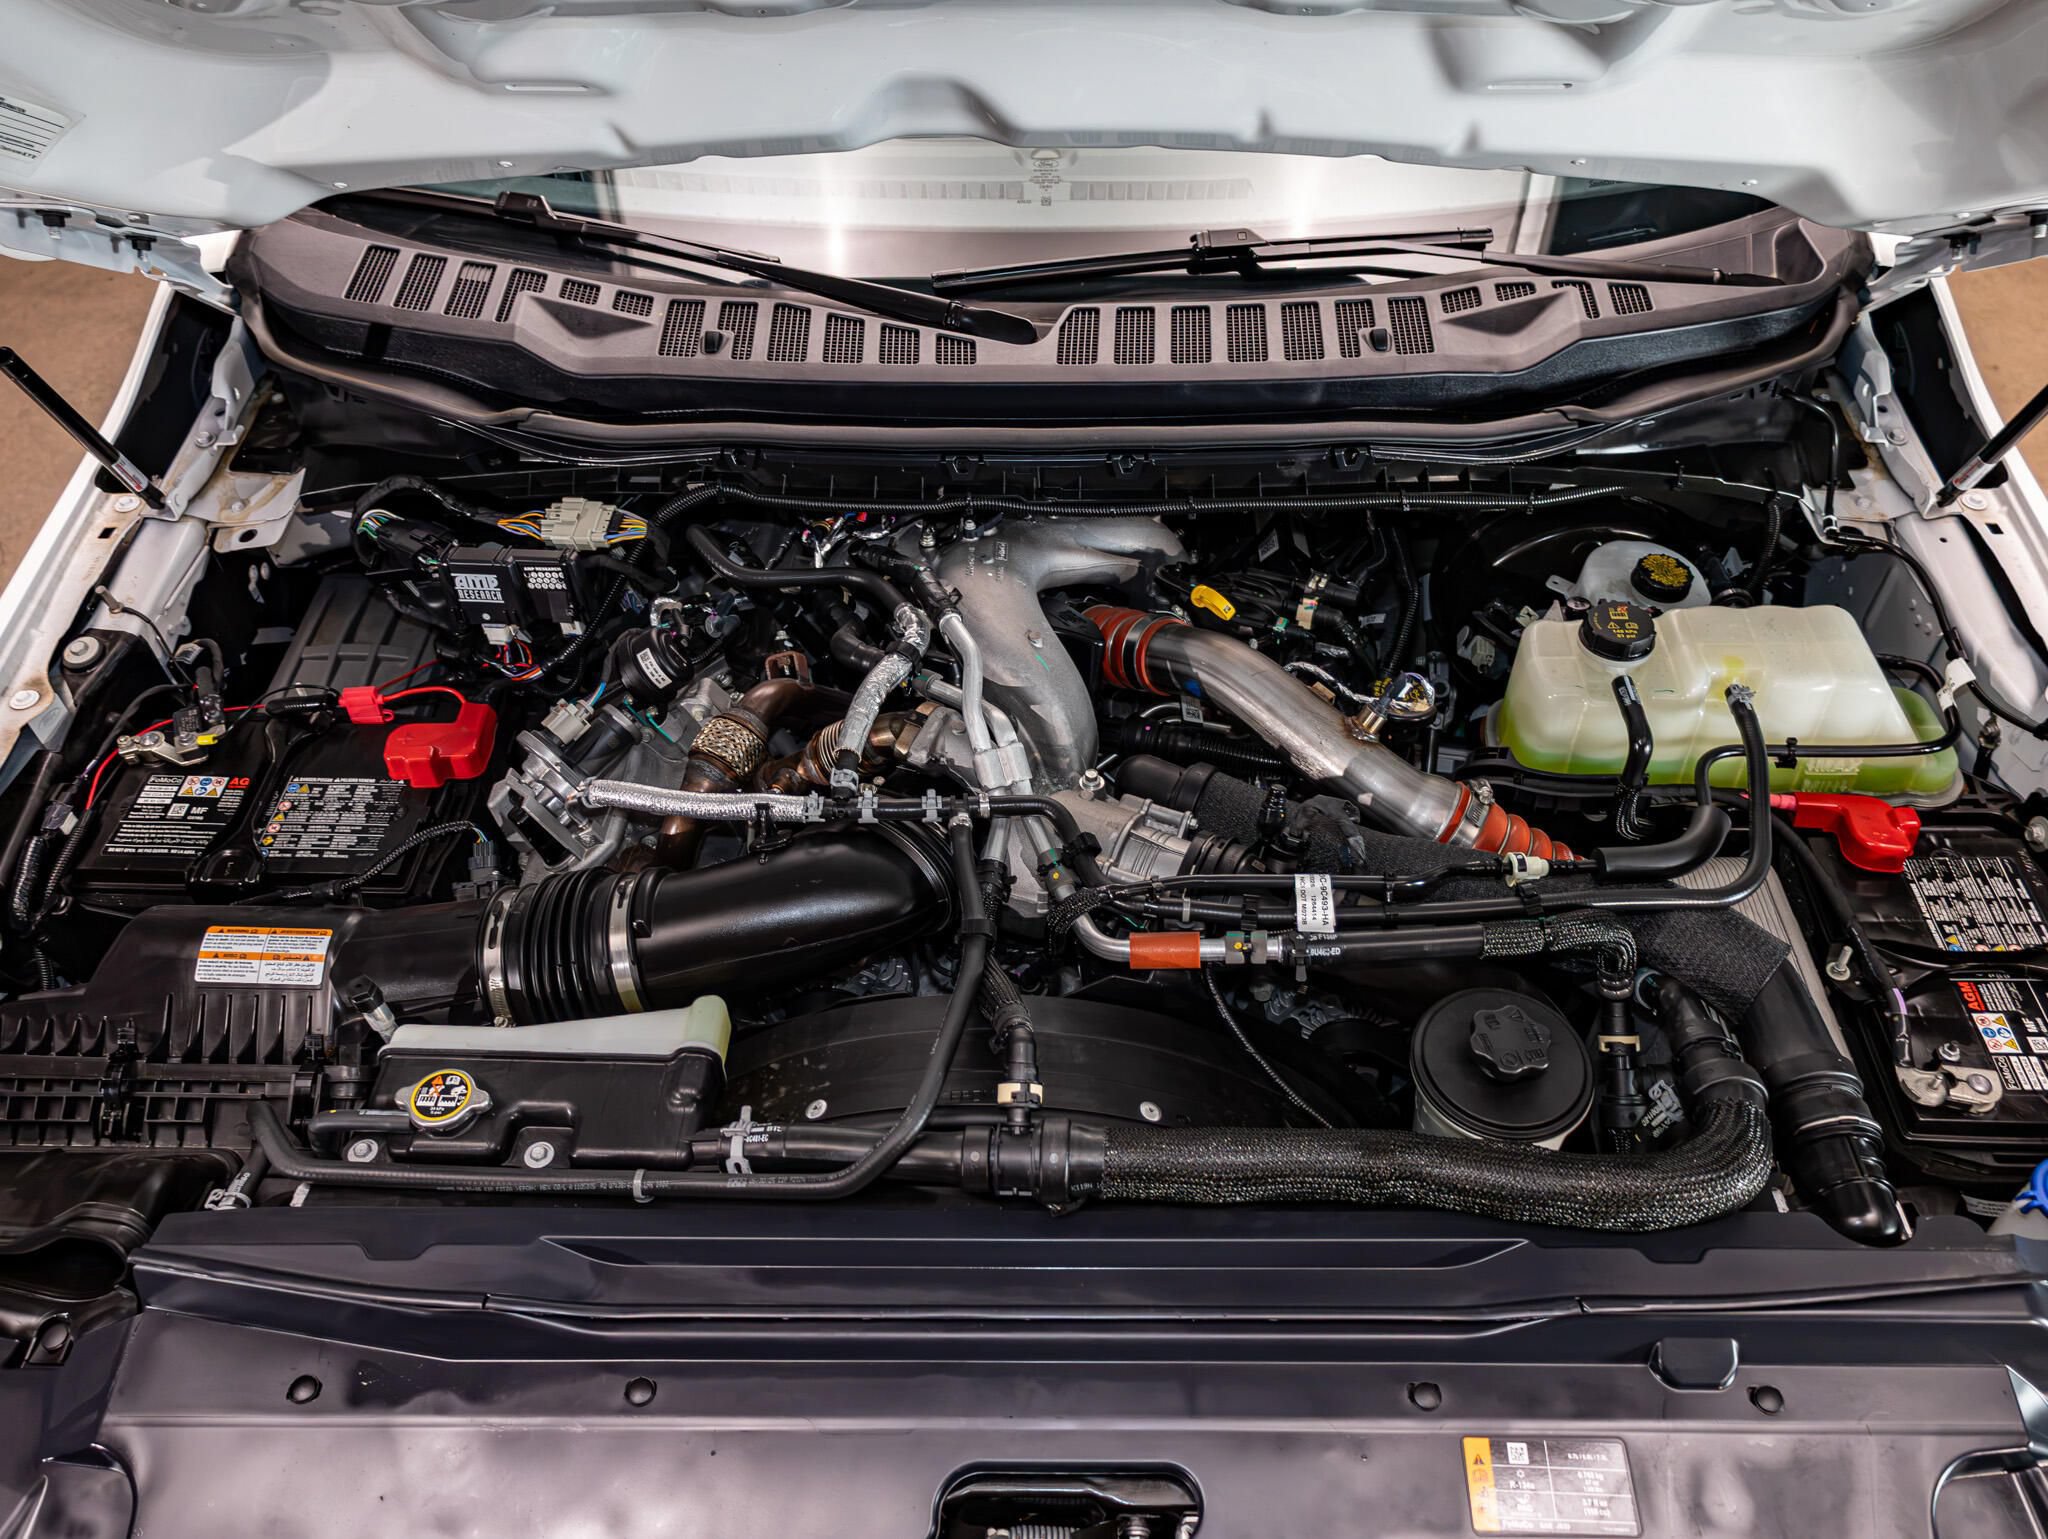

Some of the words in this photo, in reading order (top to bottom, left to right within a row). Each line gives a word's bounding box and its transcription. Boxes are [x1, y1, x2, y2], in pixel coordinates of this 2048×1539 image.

[454, 575, 500, 589] AMP
[458, 590, 503, 601] RESEARCH
[149, 776, 182, 785] FoMoCo
[190, 806, 209, 815] MF
[1957, 981, 1983, 1011] AGM
[2021, 1017, 2039, 1033] MF
[1998, 1056, 2017, 1089] FoMoCo
